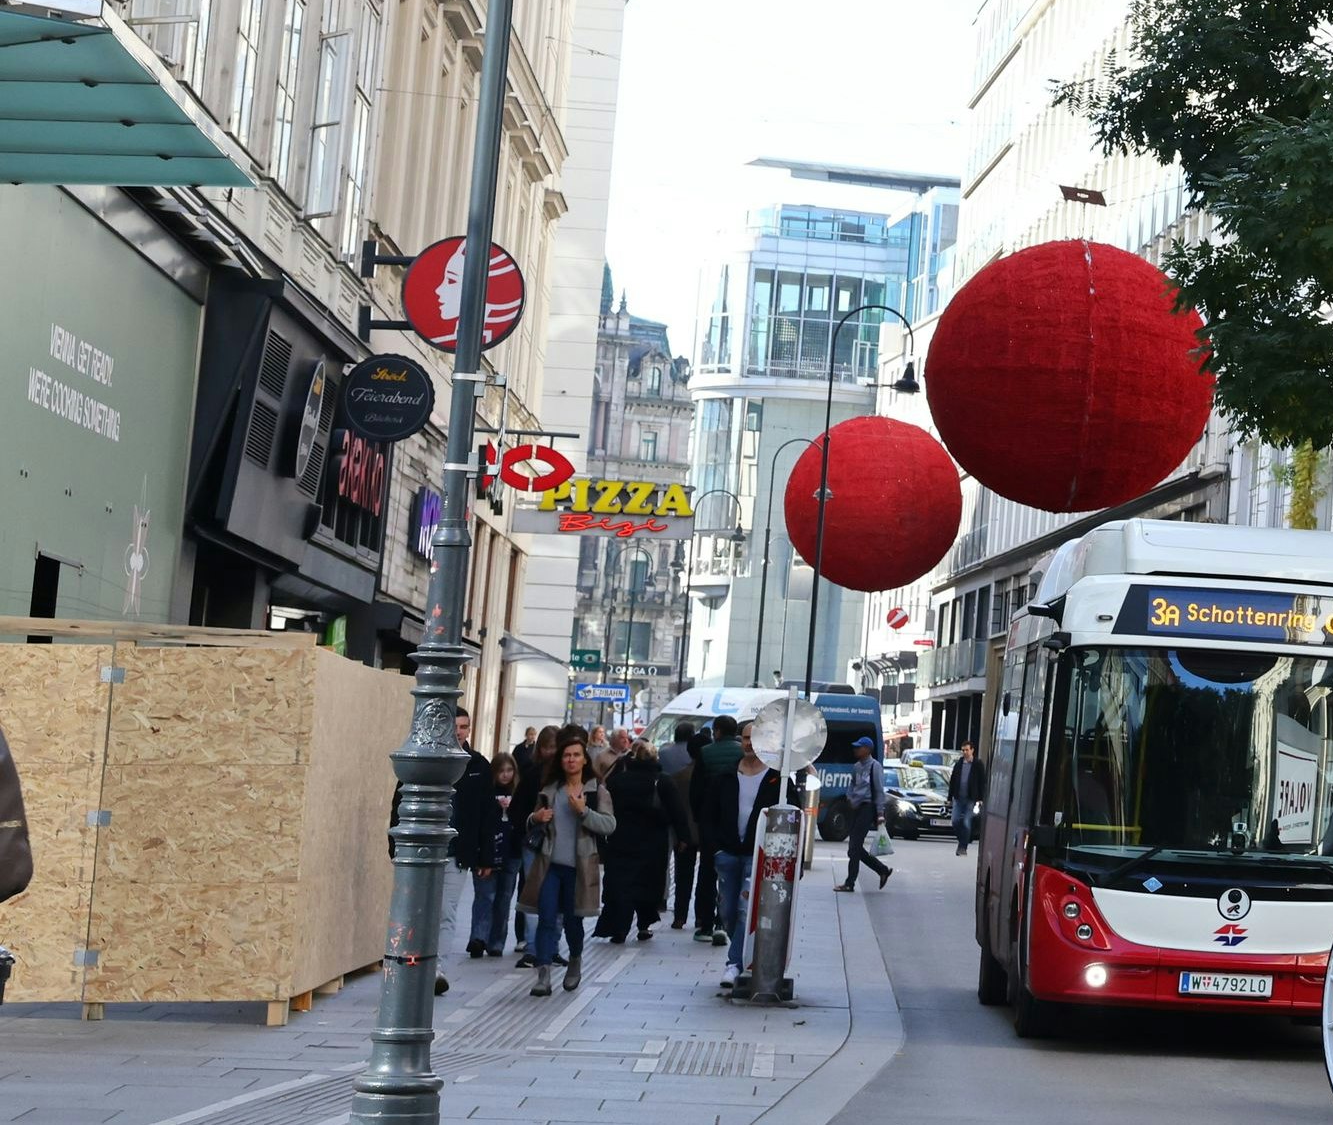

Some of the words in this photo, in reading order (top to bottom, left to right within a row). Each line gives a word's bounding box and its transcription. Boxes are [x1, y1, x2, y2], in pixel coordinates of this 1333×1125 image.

[50, 322, 76, 368] VIENNA
[77, 340, 93, 376] GET
[51, 379, 83, 425] COOKING
[351, 387, 425, 405] Feierabend
[538, 478, 695, 517] PIZZA
[558, 513, 668, 538] Bizi
[1150, 597, 1181, 627] 3A
[1186, 602, 1317, 633] Schottenring
